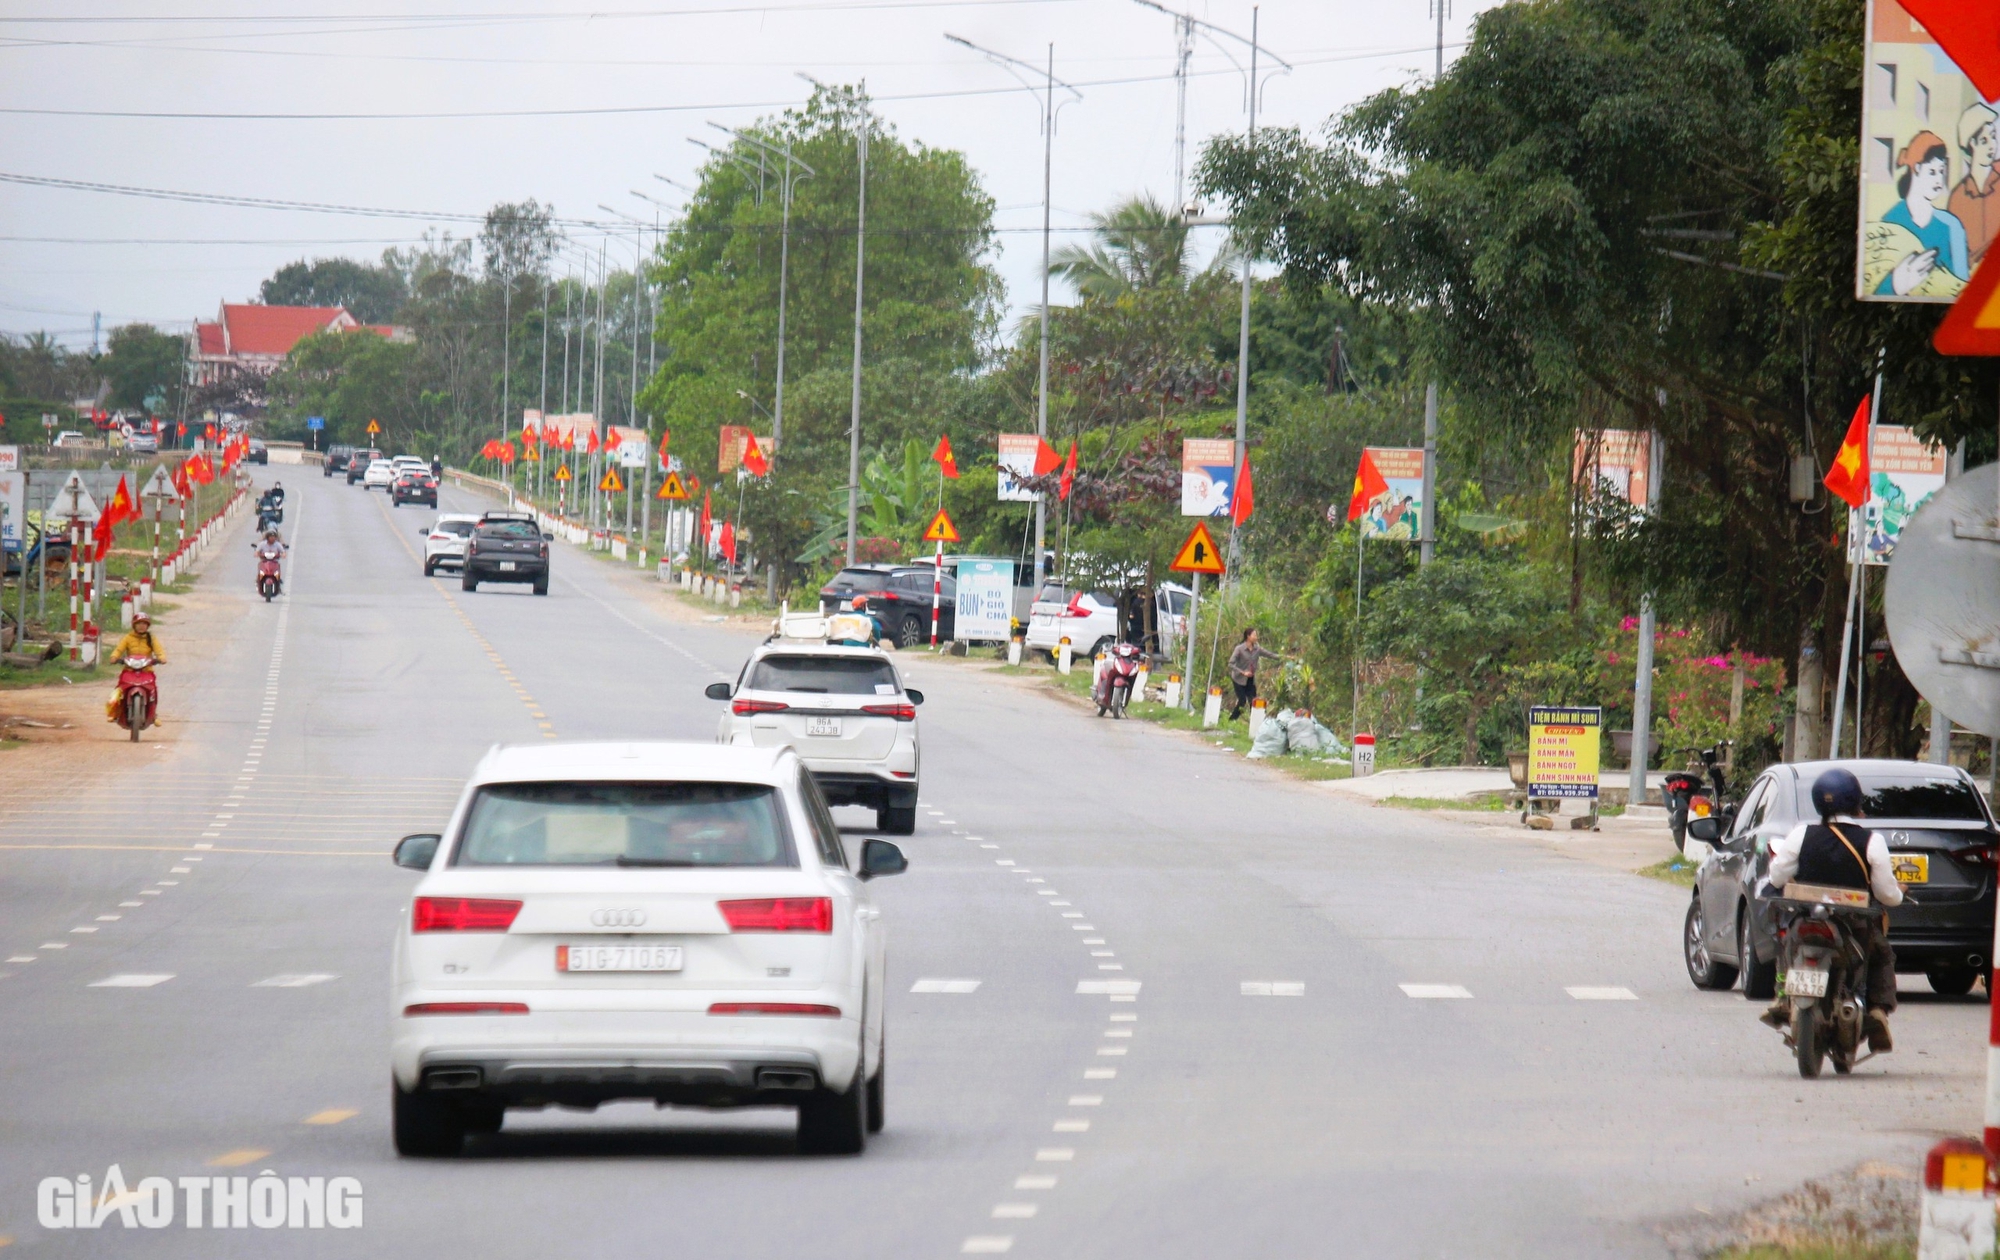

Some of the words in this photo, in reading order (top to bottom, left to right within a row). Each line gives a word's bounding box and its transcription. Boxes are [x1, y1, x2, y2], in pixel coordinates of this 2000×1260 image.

[959, 588, 979, 616] BÚN
[1534, 711, 1550, 725] TIỆM
[1552, 710, 1570, 724] BÁNH
[1581, 713, 1597, 724] SURI
[1537, 737, 1557, 745] BÁNH
[1358, 751, 1371, 762] H2
[1537, 749, 1557, 757] BÁNH
[1536, 760, 1556, 769] BÁNH
[1536, 772, 1556, 781] BÁNH
[1557, 773, 1575, 782] SINH
[571, 948, 678, 969] 51G-710.67
